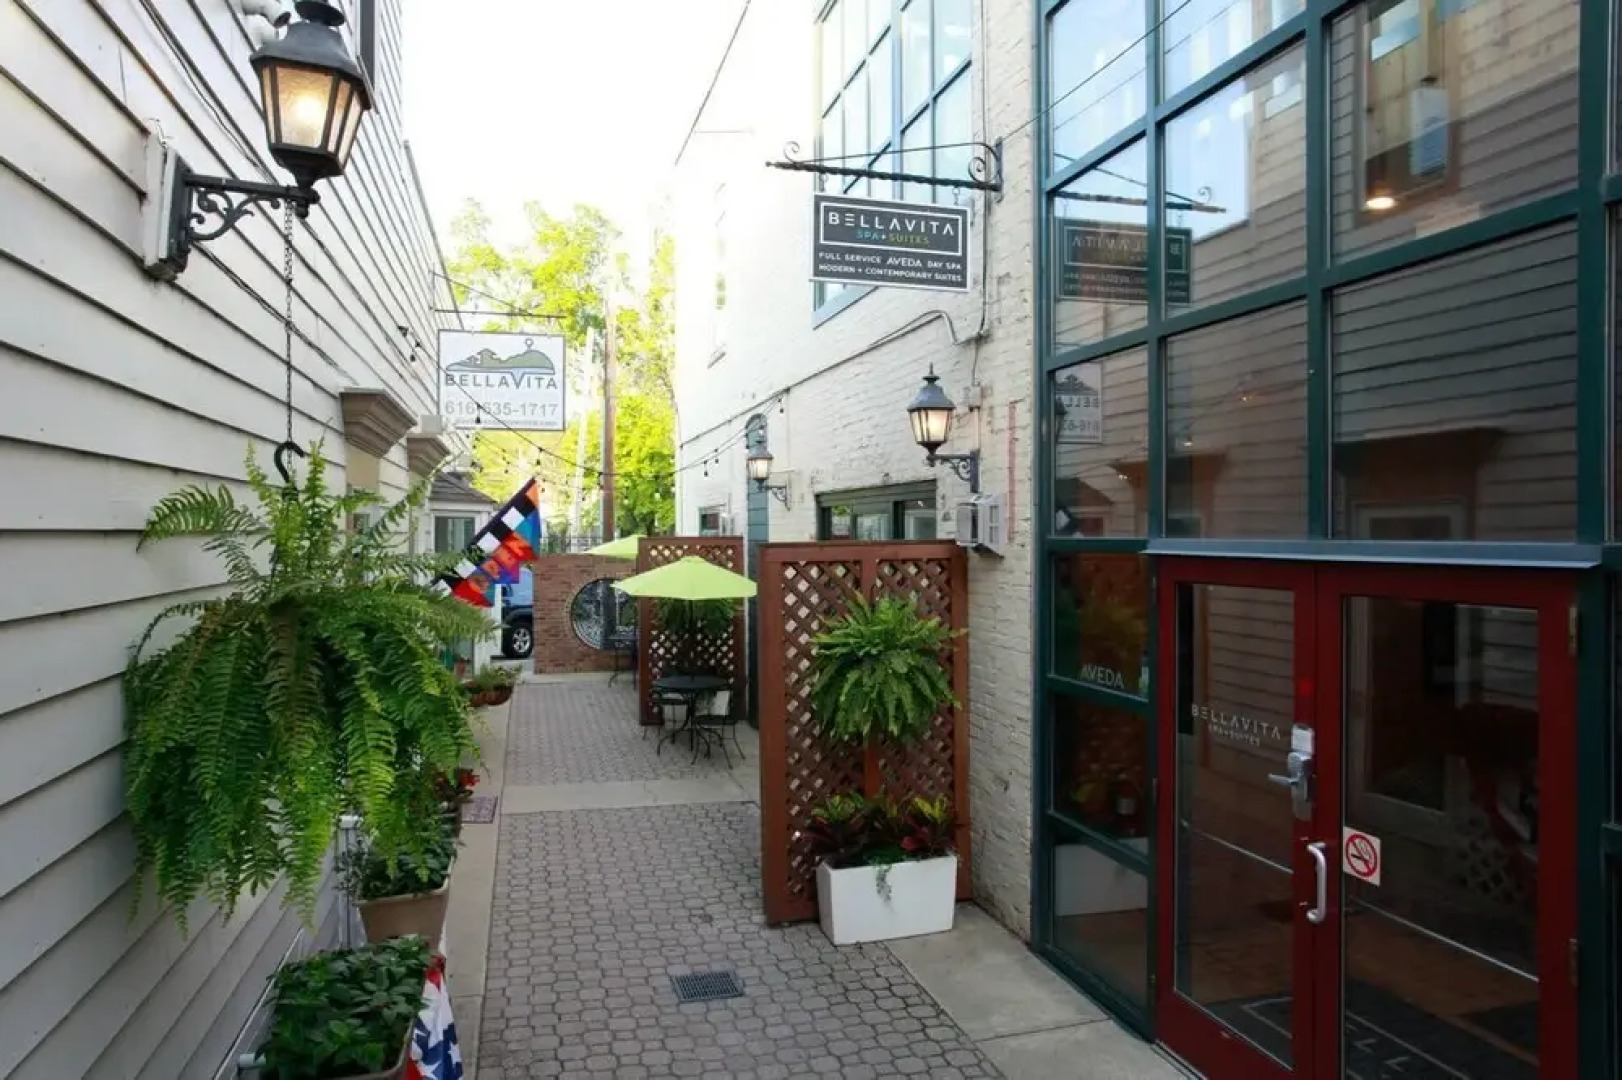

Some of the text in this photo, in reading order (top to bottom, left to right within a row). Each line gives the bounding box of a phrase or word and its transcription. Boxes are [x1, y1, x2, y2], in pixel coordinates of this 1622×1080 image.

[829, 212, 954, 236] BELLAVITA
[818, 252, 962, 270] FULL SERVICE AVEDA DAY SPA
[818, 264, 856, 273] MODERN
[864, 267, 932, 280] CONTEMPORARY
[934, 273, 962, 281] SUITES
[445, 373, 558, 389] BELLAVITA
[467, 533, 531, 594] OPEN
[1080, 664, 1124, 689] AVEDA
[1192, 703, 1281, 740] BELLAVITA
